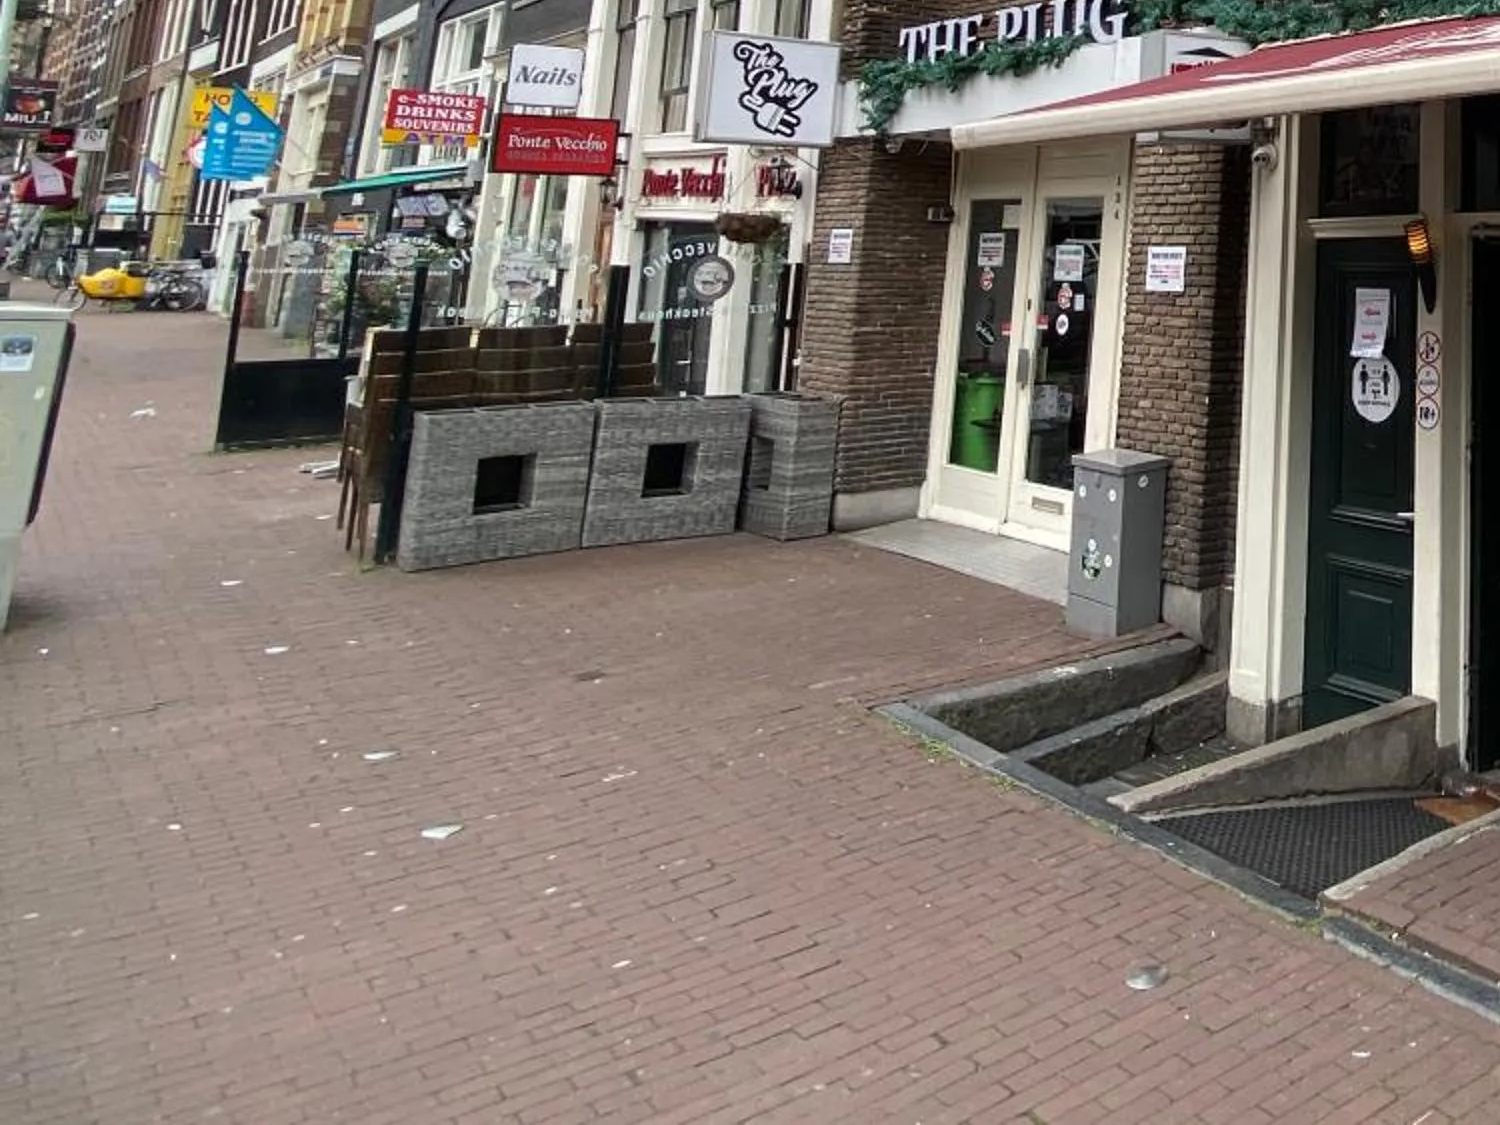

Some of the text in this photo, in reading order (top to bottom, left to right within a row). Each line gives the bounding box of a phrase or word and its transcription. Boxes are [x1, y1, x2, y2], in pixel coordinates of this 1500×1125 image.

[899, 13, 985, 65] THE
[737, 43, 782, 70] The
[515, 64, 577, 86] Nails
[748, 68, 817, 109] Plug
[397, 93, 479, 109] e-SMOKE
[396, 105, 477, 122] DRINKS
[393, 117, 475, 133] SOUVENIRS
[507, 133, 551, 150] Ponte
